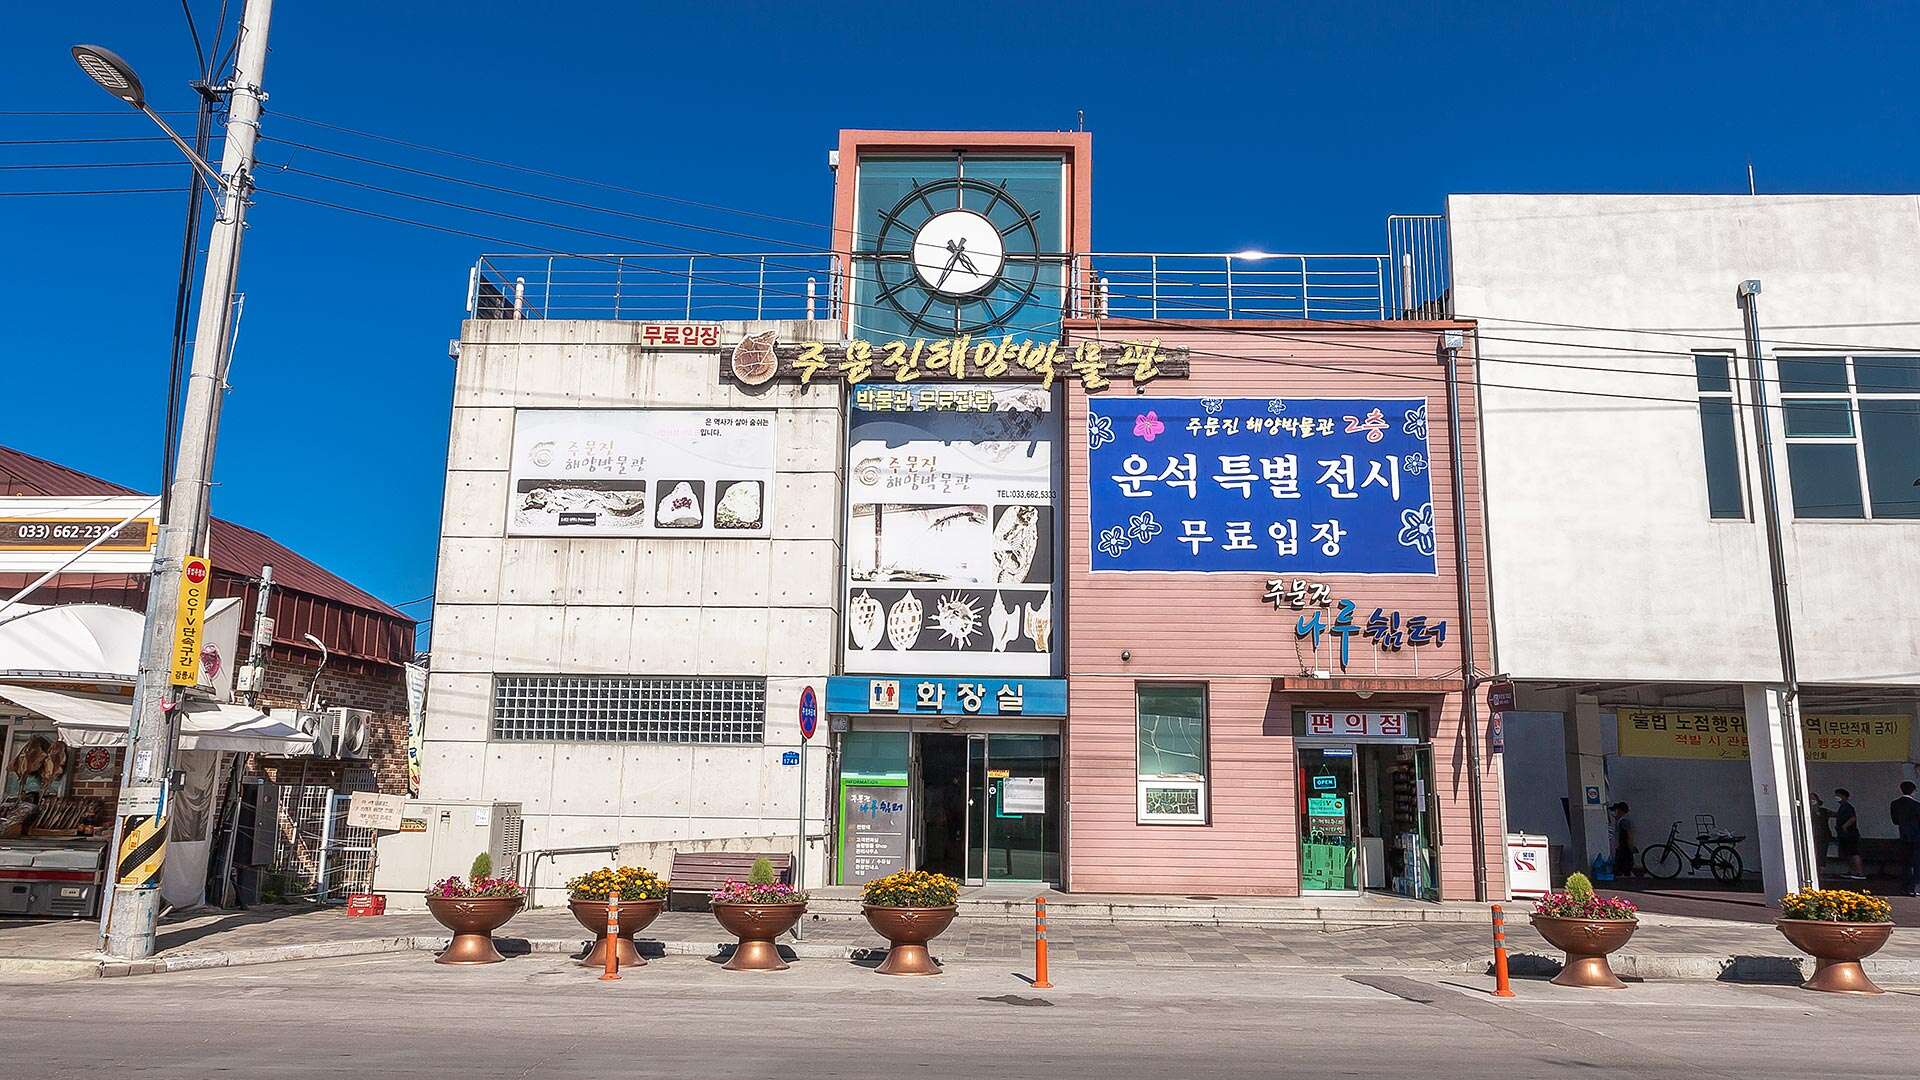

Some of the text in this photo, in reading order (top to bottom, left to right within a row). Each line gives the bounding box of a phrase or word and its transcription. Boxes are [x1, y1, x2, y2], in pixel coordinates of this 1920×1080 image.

[643, 326, 720, 346] 무료입장
[856, 390, 913, 412] 박물관
[714, 418, 733, 426] 역사가
[1186, 408, 1390, 443] 주문진 해양박물관 2층
[700, 429, 722, 437] 입니다.
[888, 456, 938, 473] 주문진
[886, 472, 973, 493] 해양박물관
[1111, 453, 1401, 502] 운석 특별 전시
[18, 525, 50, 539] 033)
[916, 682, 1023, 712] 화장실
[1311, 713, 1402, 735] 편의점
